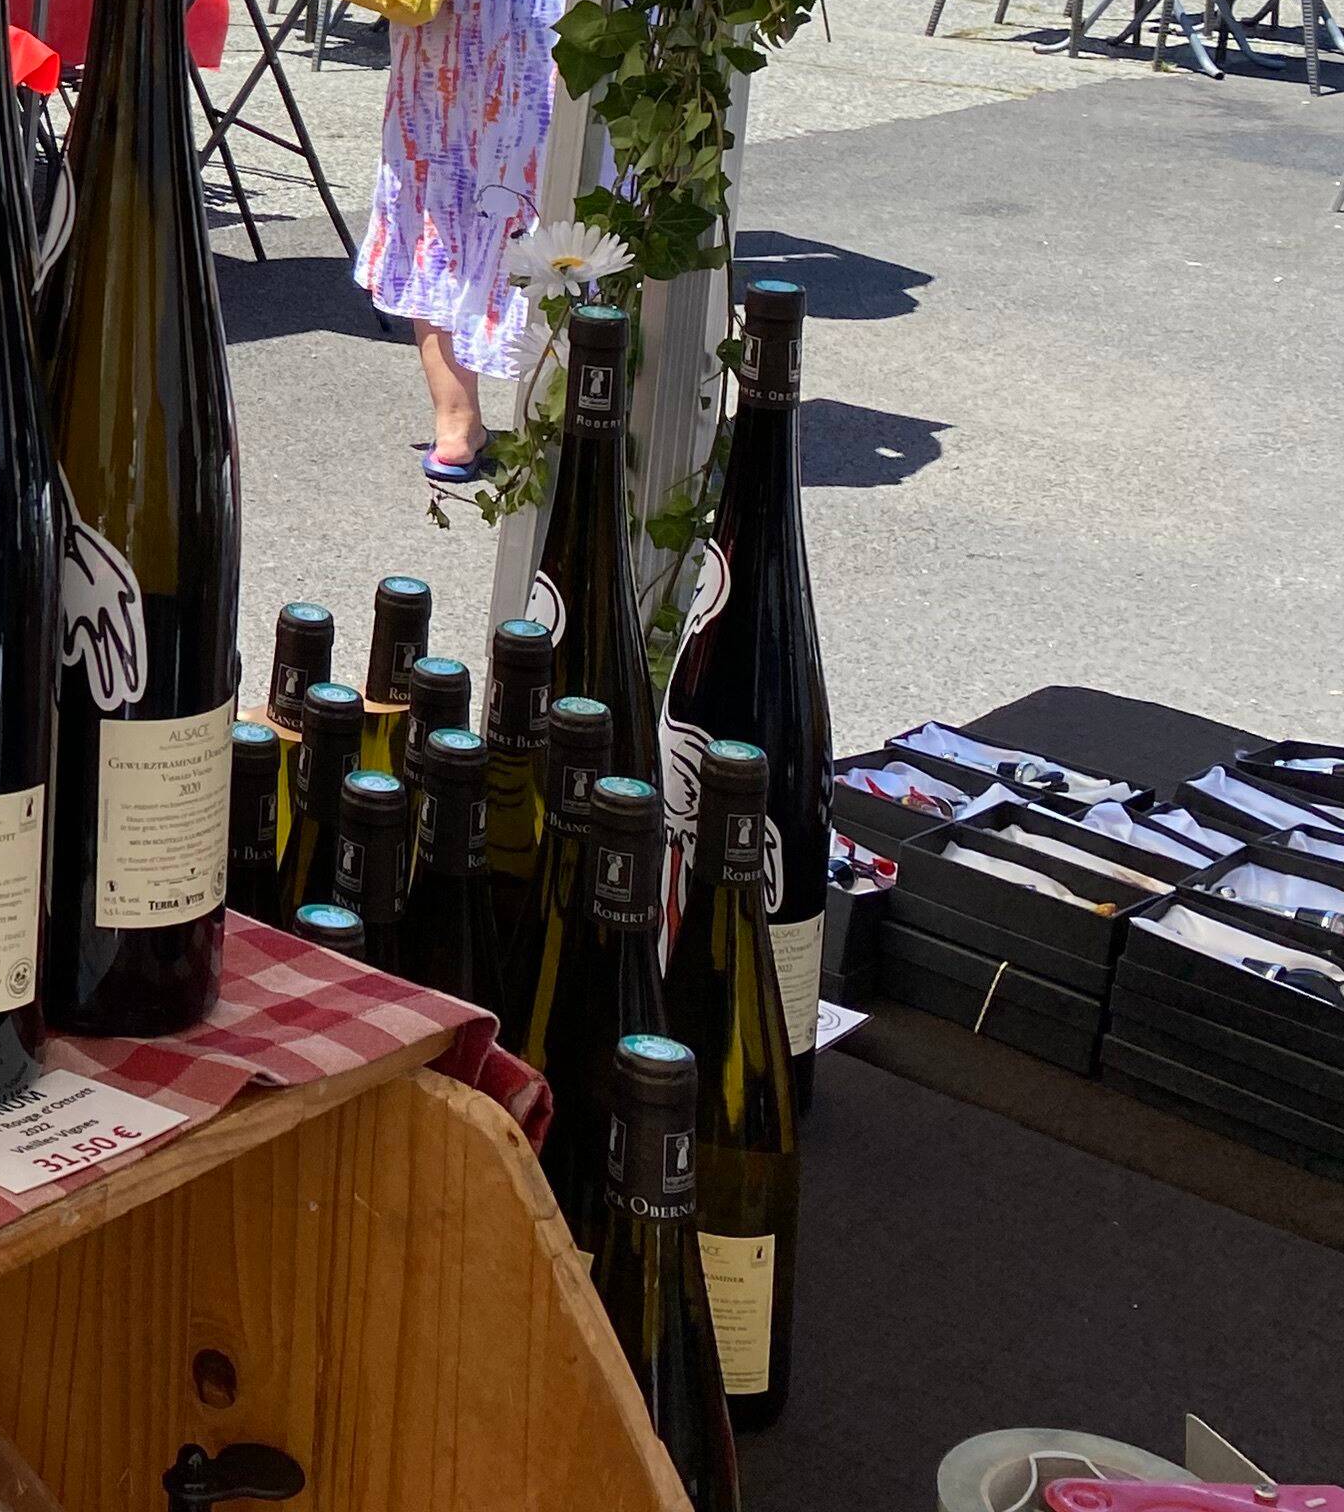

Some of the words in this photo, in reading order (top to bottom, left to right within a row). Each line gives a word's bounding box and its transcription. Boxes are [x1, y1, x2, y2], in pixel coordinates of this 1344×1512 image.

[169, 723, 209, 742] ALSACE
[148, 898, 179, 911] TERRA
[593, 899, 645, 923] ROBERT
[2, 1112, 41, 1131] Rouge
[41, 1086, 97, 1118] d'Ottrott
[9, 1135, 61, 1155] Vieilles
[60, 1118, 100, 1139] Vignes
[19, 1122, 55, 1138] 2022
[32, 1136, 118, 1174] 31,50
[113, 1125, 143, 1141] €
